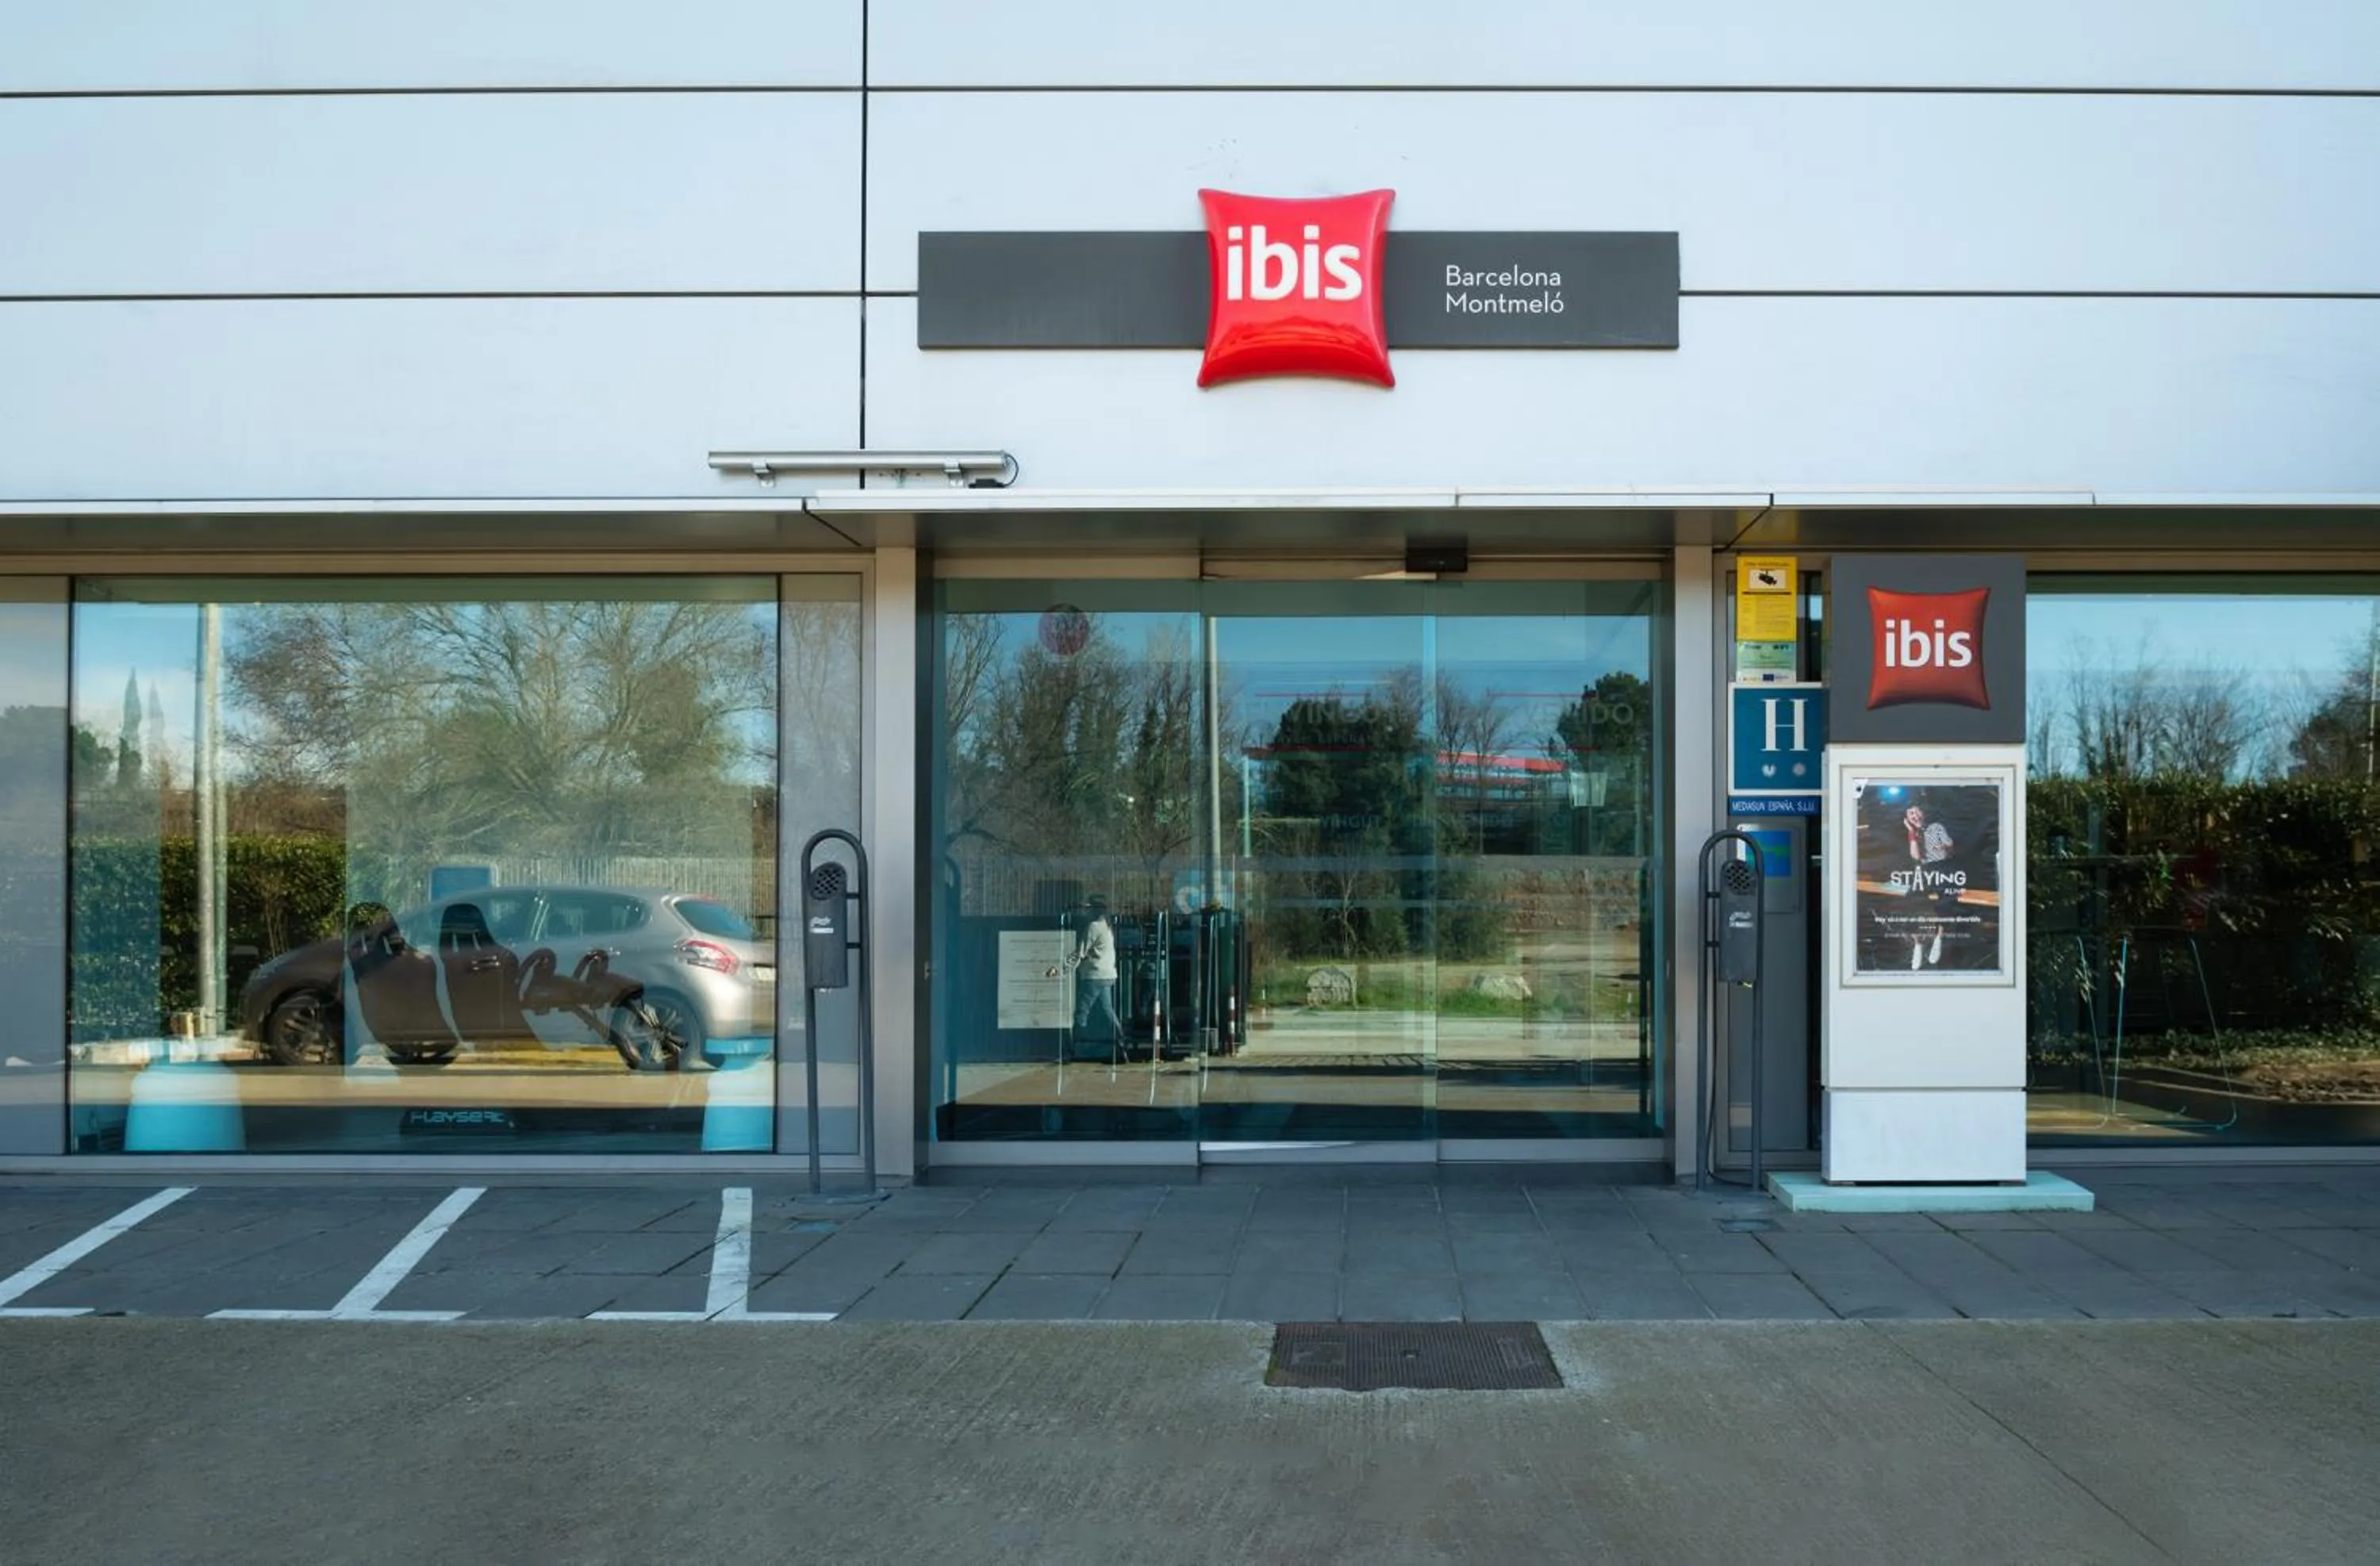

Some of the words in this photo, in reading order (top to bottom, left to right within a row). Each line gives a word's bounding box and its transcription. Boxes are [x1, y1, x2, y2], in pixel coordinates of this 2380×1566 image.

[1227, 225, 1363, 301] ibis
[1446, 263, 1561, 286] Barcelona
[1446, 290, 1564, 313] Montmeló
[1886, 619, 1972, 667] ibis
[1761, 699, 1809, 751] H
[1891, 866, 1967, 892] STAYING
